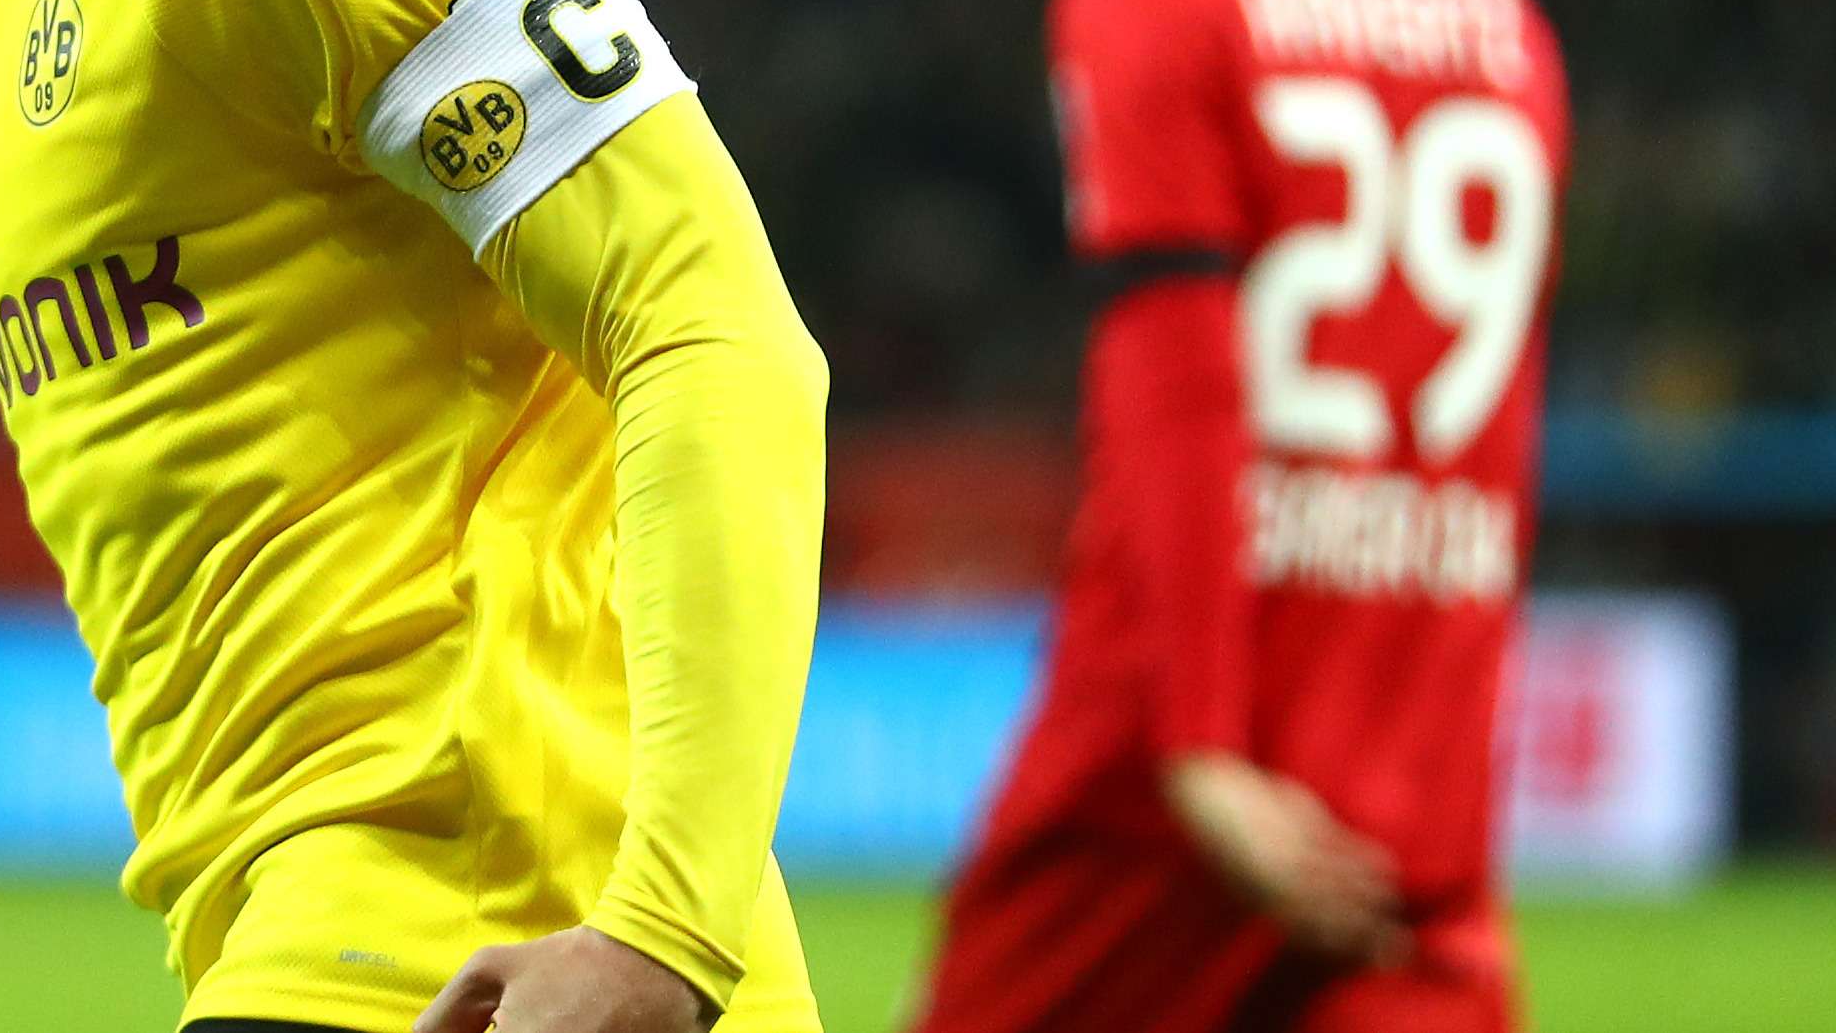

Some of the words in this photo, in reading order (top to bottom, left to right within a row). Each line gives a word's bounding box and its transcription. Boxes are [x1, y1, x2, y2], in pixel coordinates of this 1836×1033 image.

[35, 82, 53, 113] 09
[431, 93, 514, 178] BVB
[474, 141, 503, 173] 09
[1242, 77, 1552, 459] 29
